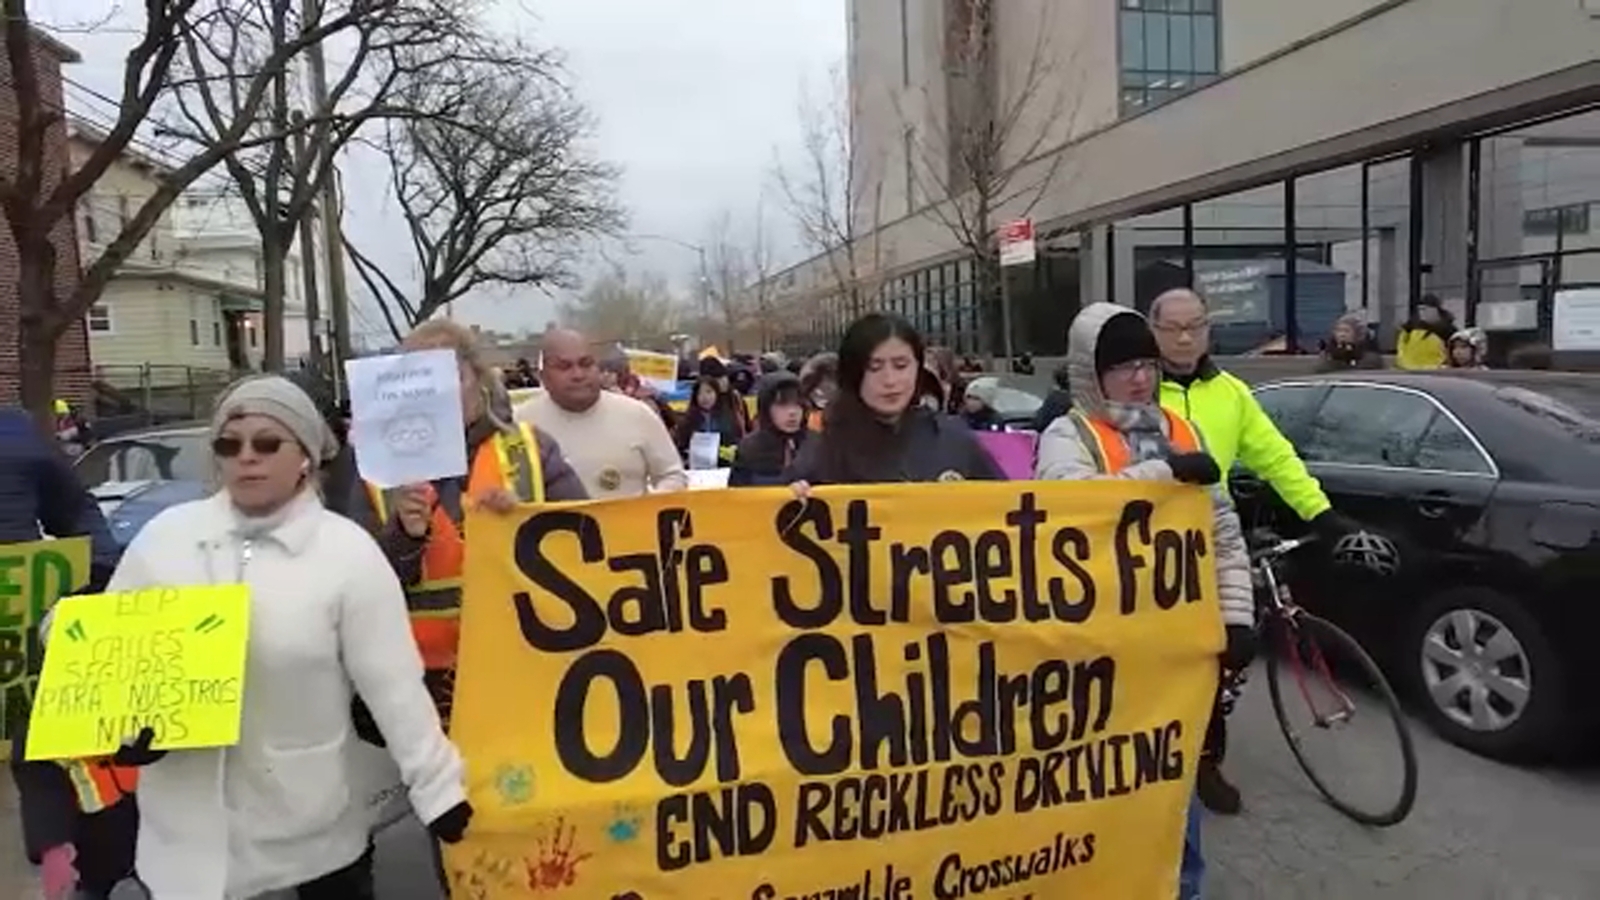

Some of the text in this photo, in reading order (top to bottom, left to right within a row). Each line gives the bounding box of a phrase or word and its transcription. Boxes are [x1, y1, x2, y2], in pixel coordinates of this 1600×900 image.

[513, 508, 729, 653] Safe
[771, 492, 1096, 631] Streets
[38, 683, 102, 718] PARA
[127, 676, 238, 713] NUESTROS
[64, 653, 187, 682] SEGURAS
[554, 630, 1115, 788] Our Children
[656, 720, 1184, 872] END RECKLESS DRIVING
[933, 832, 1096, 900] Crosswalks
